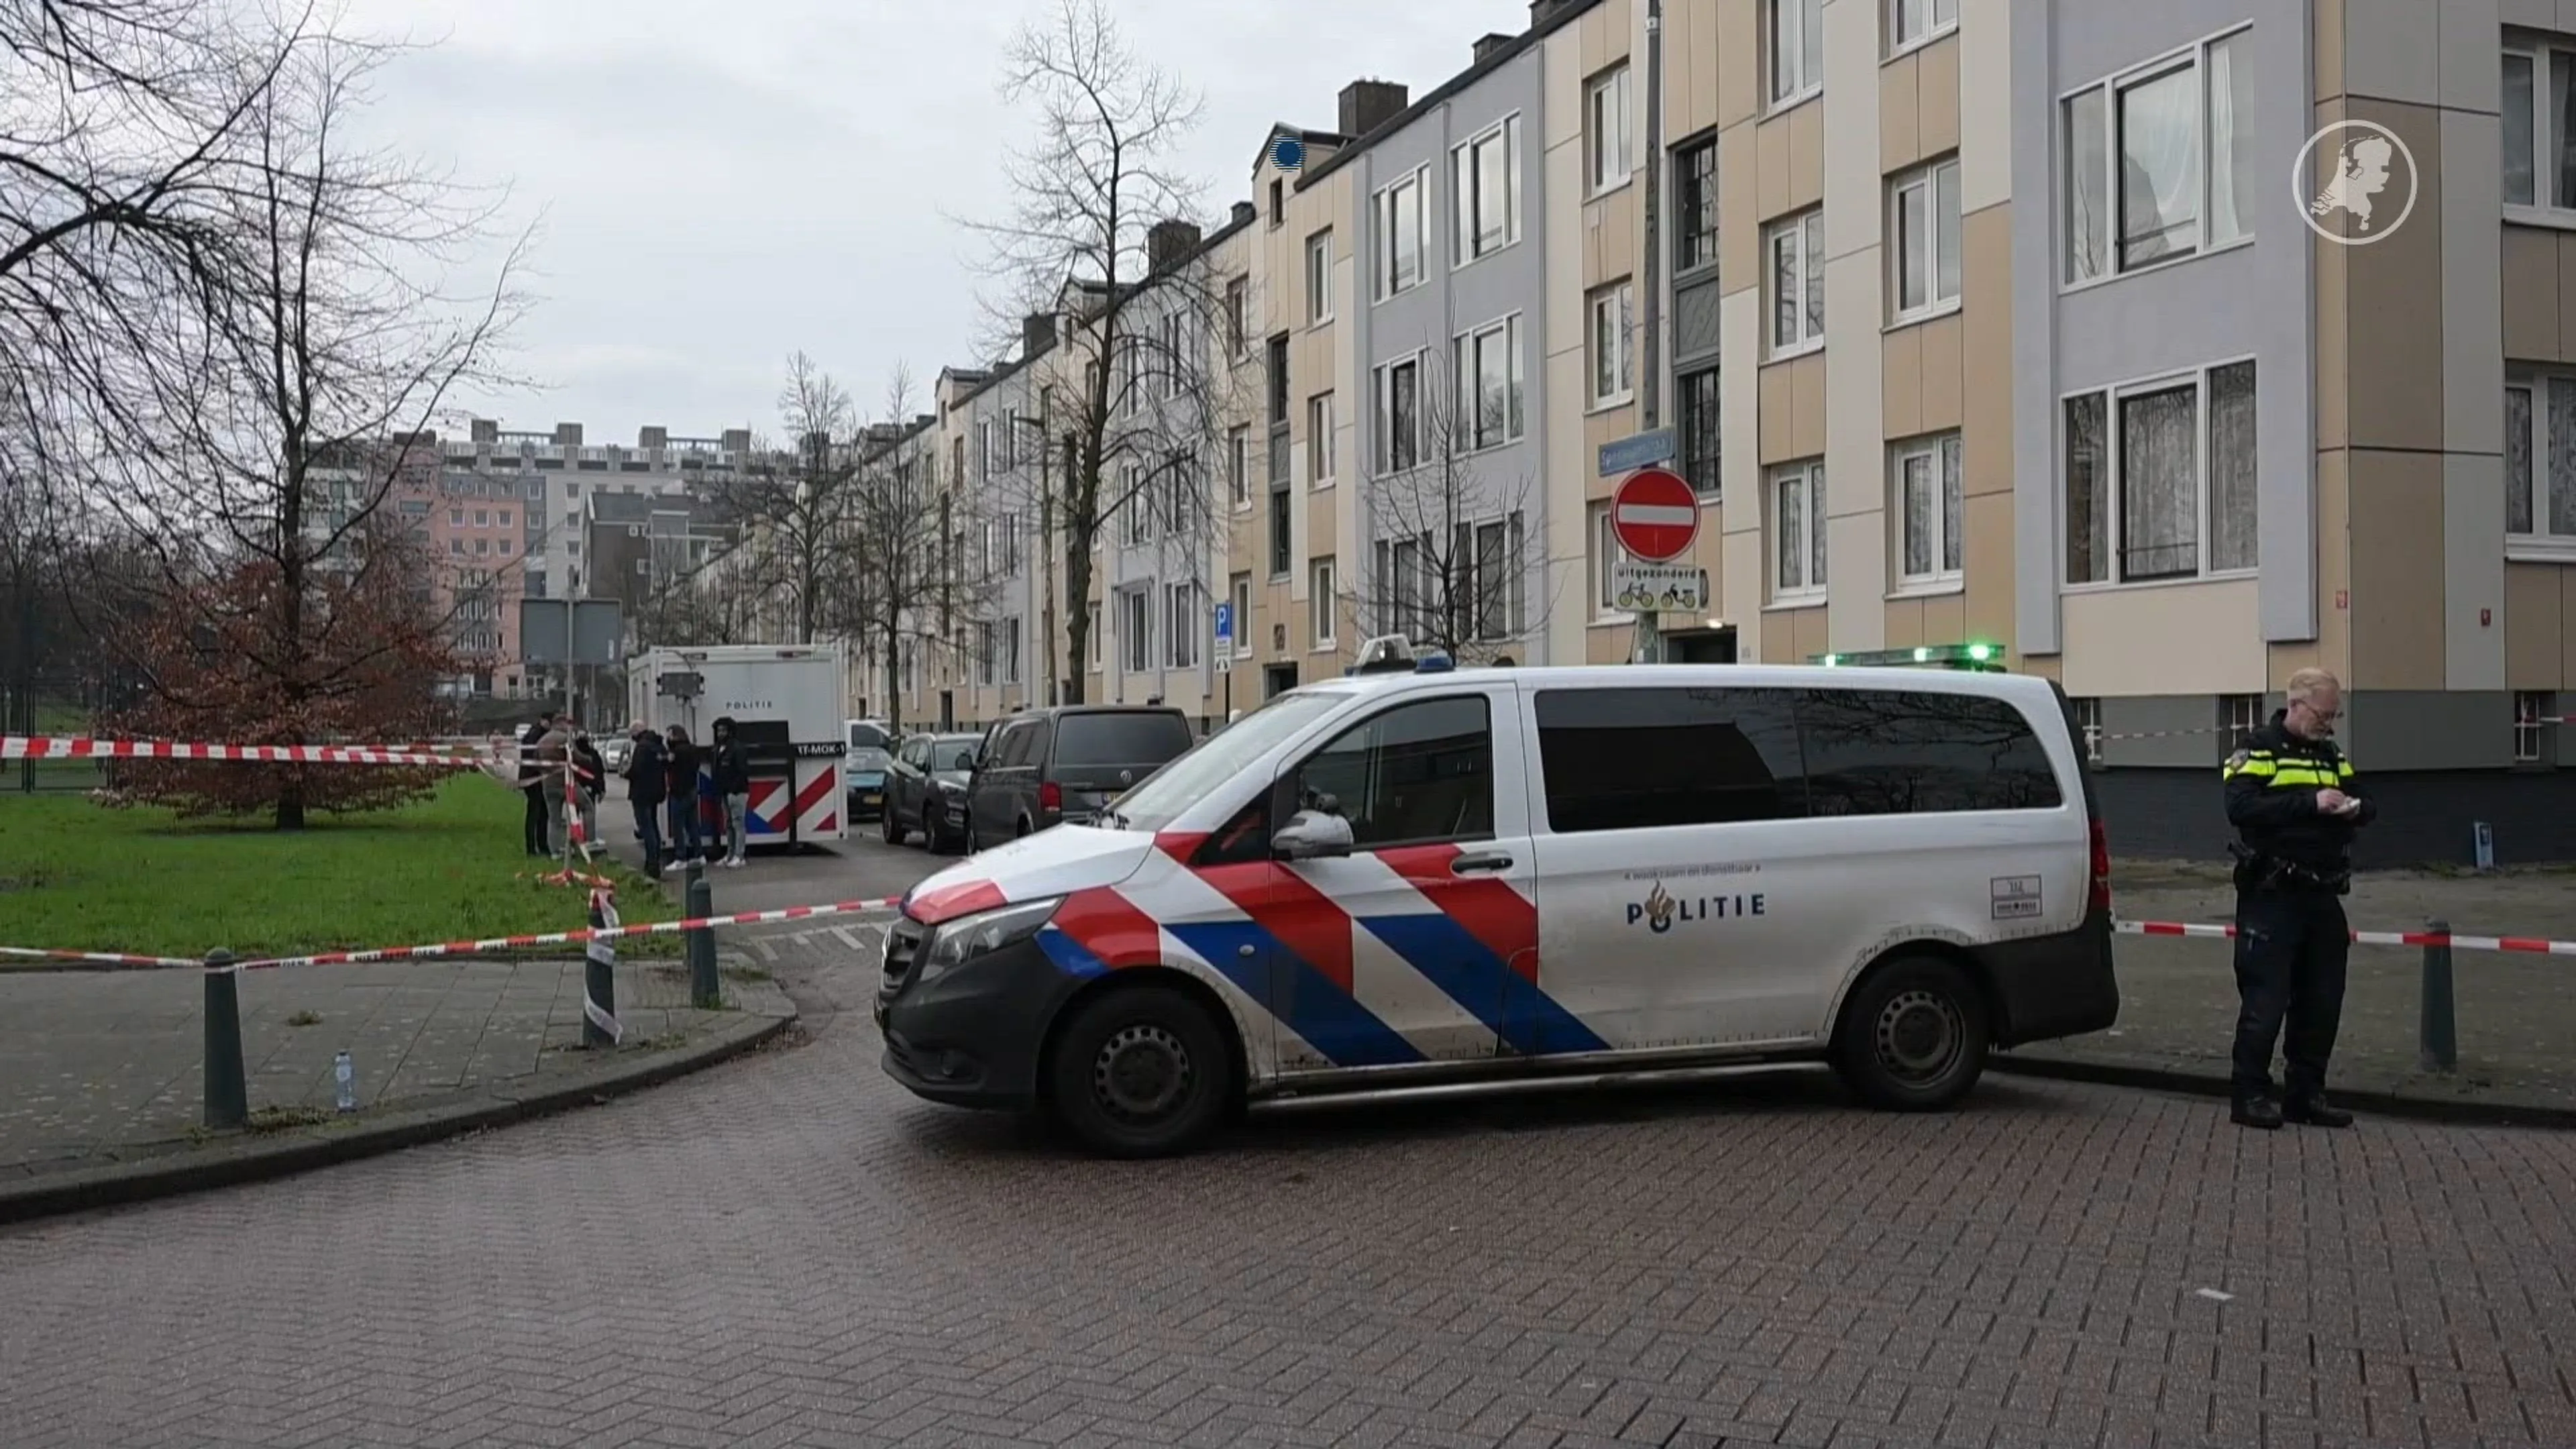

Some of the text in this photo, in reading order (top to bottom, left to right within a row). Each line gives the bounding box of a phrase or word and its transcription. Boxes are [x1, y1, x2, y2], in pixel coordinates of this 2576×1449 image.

[1618, 568, 1696, 580] uitgezonderd
[1218, 607, 1227, 633] P
[726, 700, 771, 710] POLITIE
[1627, 894, 1764, 933] POLITIE
